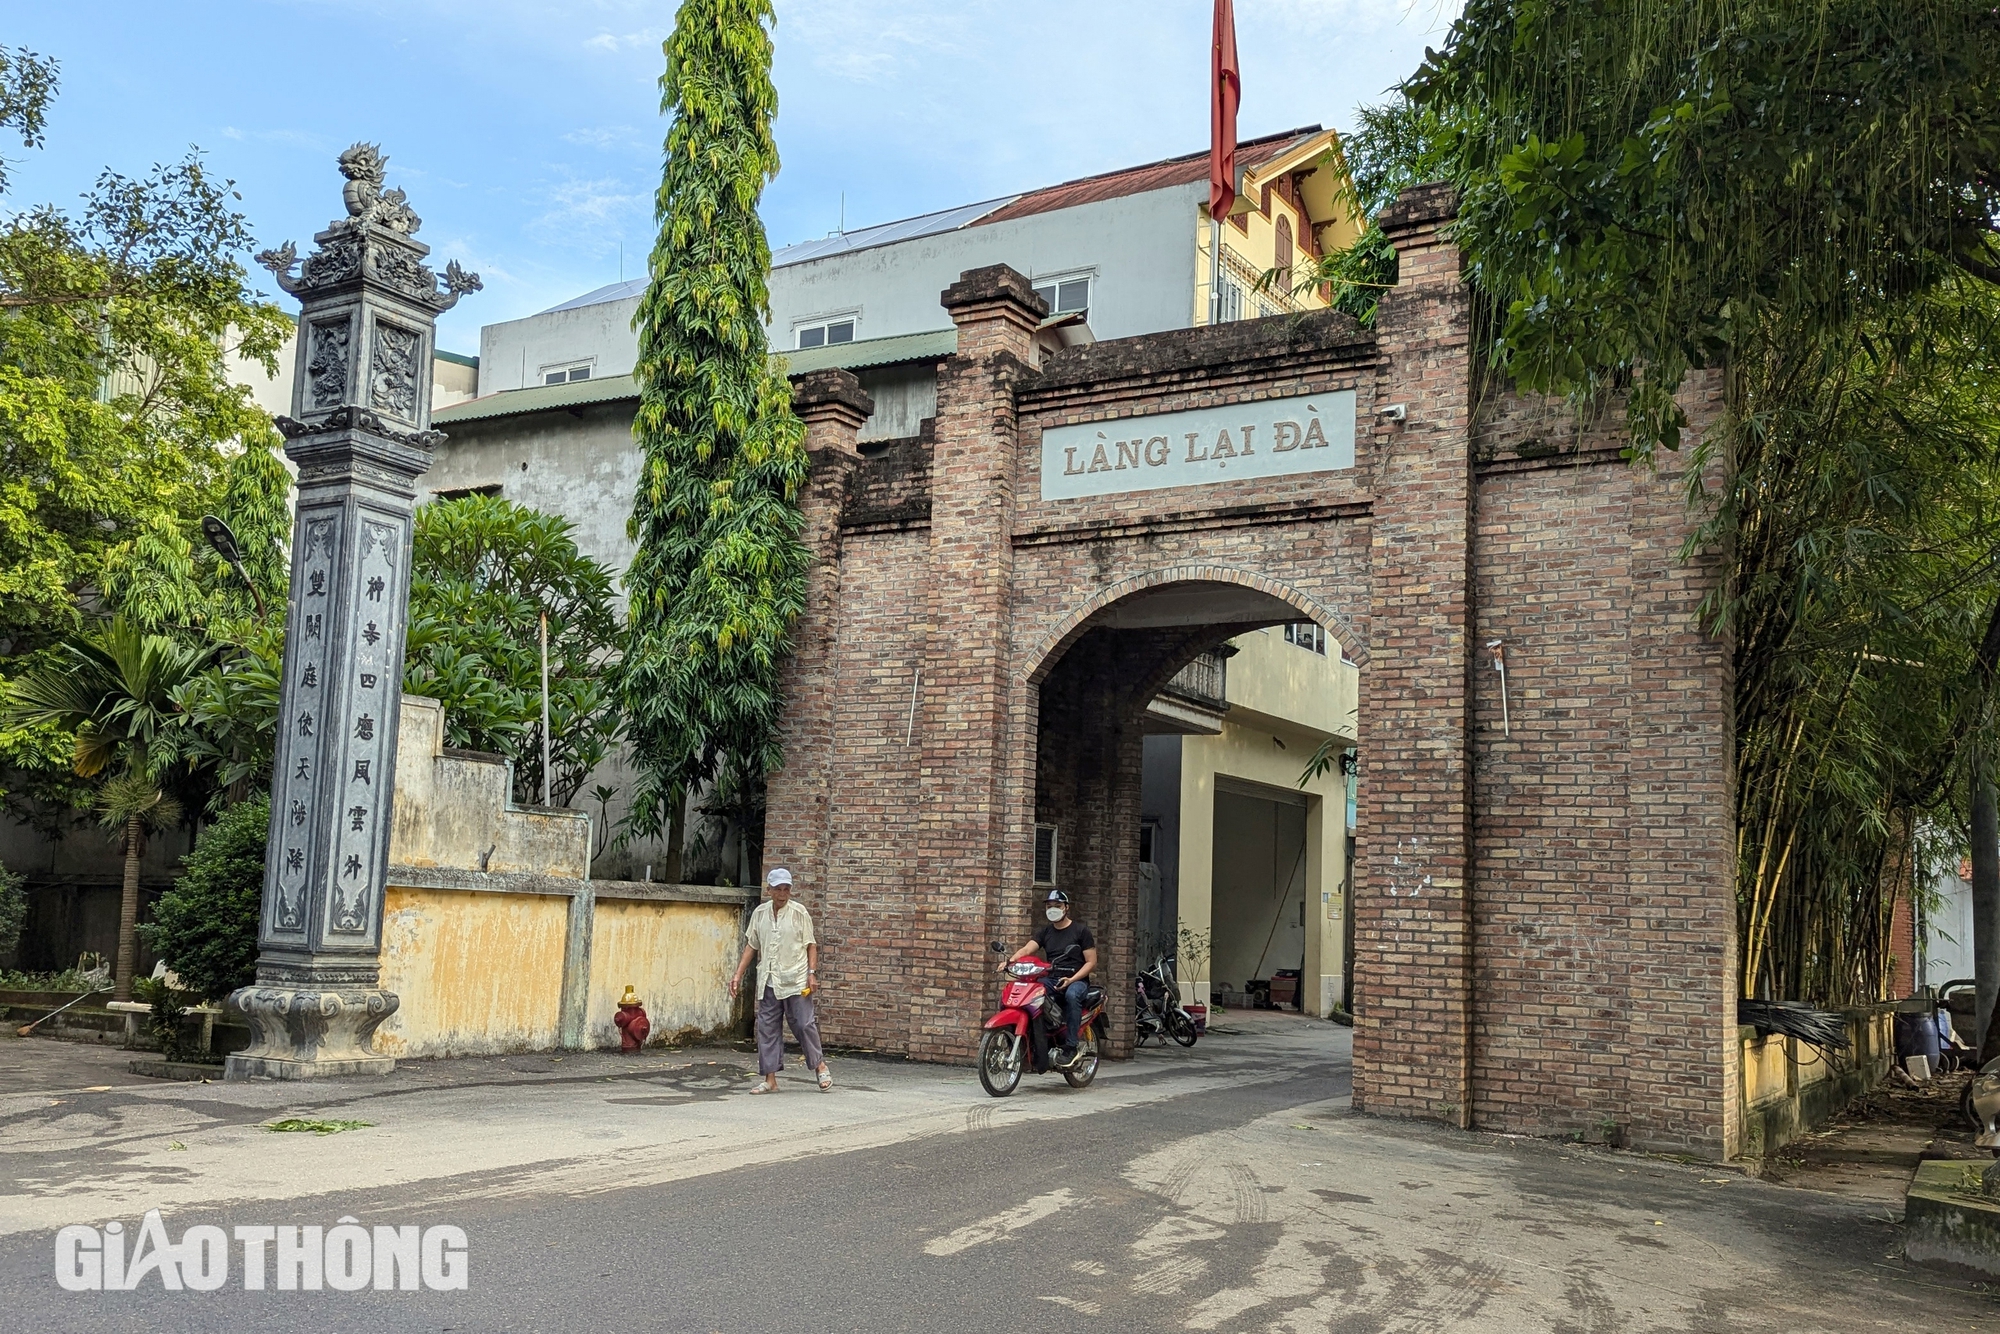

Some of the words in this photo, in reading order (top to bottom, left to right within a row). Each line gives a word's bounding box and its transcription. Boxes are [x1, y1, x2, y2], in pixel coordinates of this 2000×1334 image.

[1063, 431, 1171, 475] LÀNG
[1184, 425, 1256, 468] LẠI
[1272, 403, 1330, 453] ĐÀ
